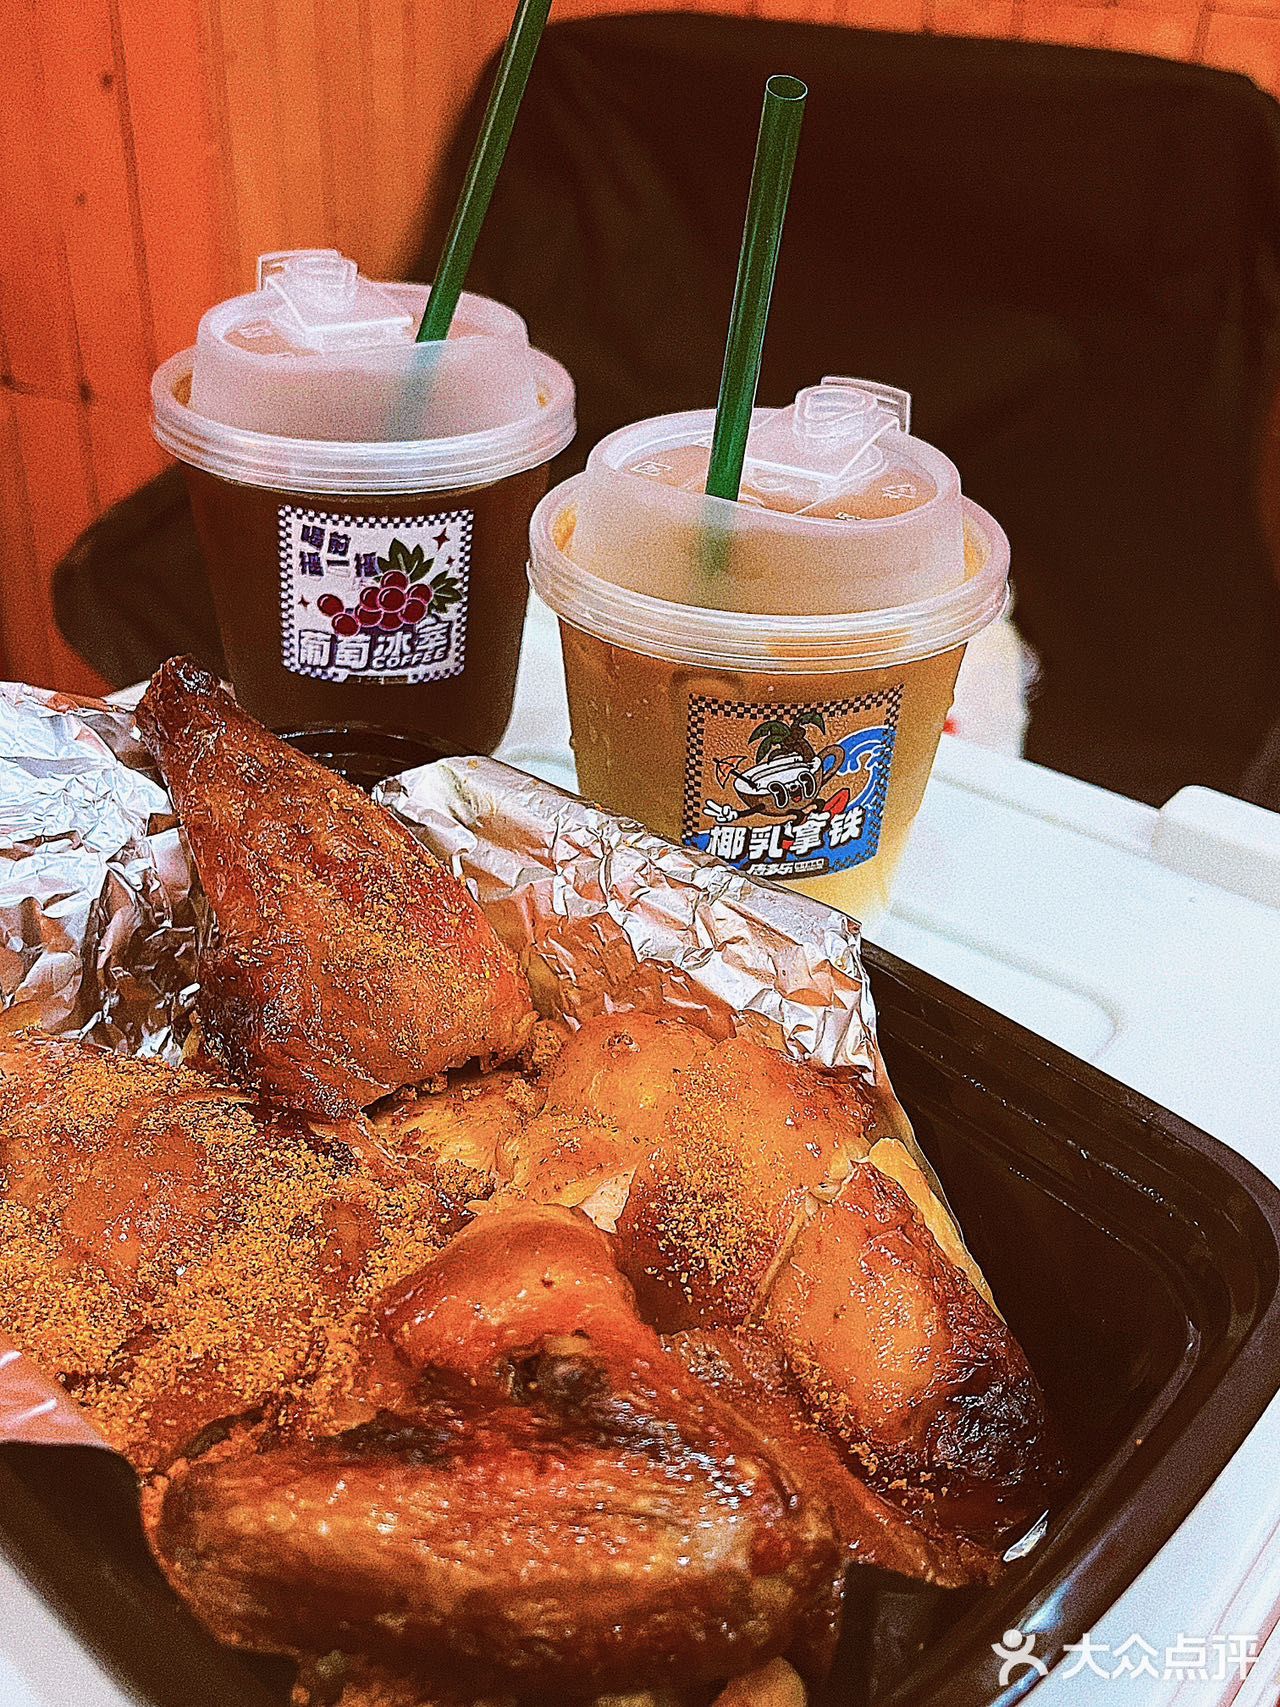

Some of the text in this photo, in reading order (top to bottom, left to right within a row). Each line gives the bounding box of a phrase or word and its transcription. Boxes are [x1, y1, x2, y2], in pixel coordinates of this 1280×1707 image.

[372, 649, 446, 669] COFFEE
[706, 806, 865, 860] 椰乳拿铁
